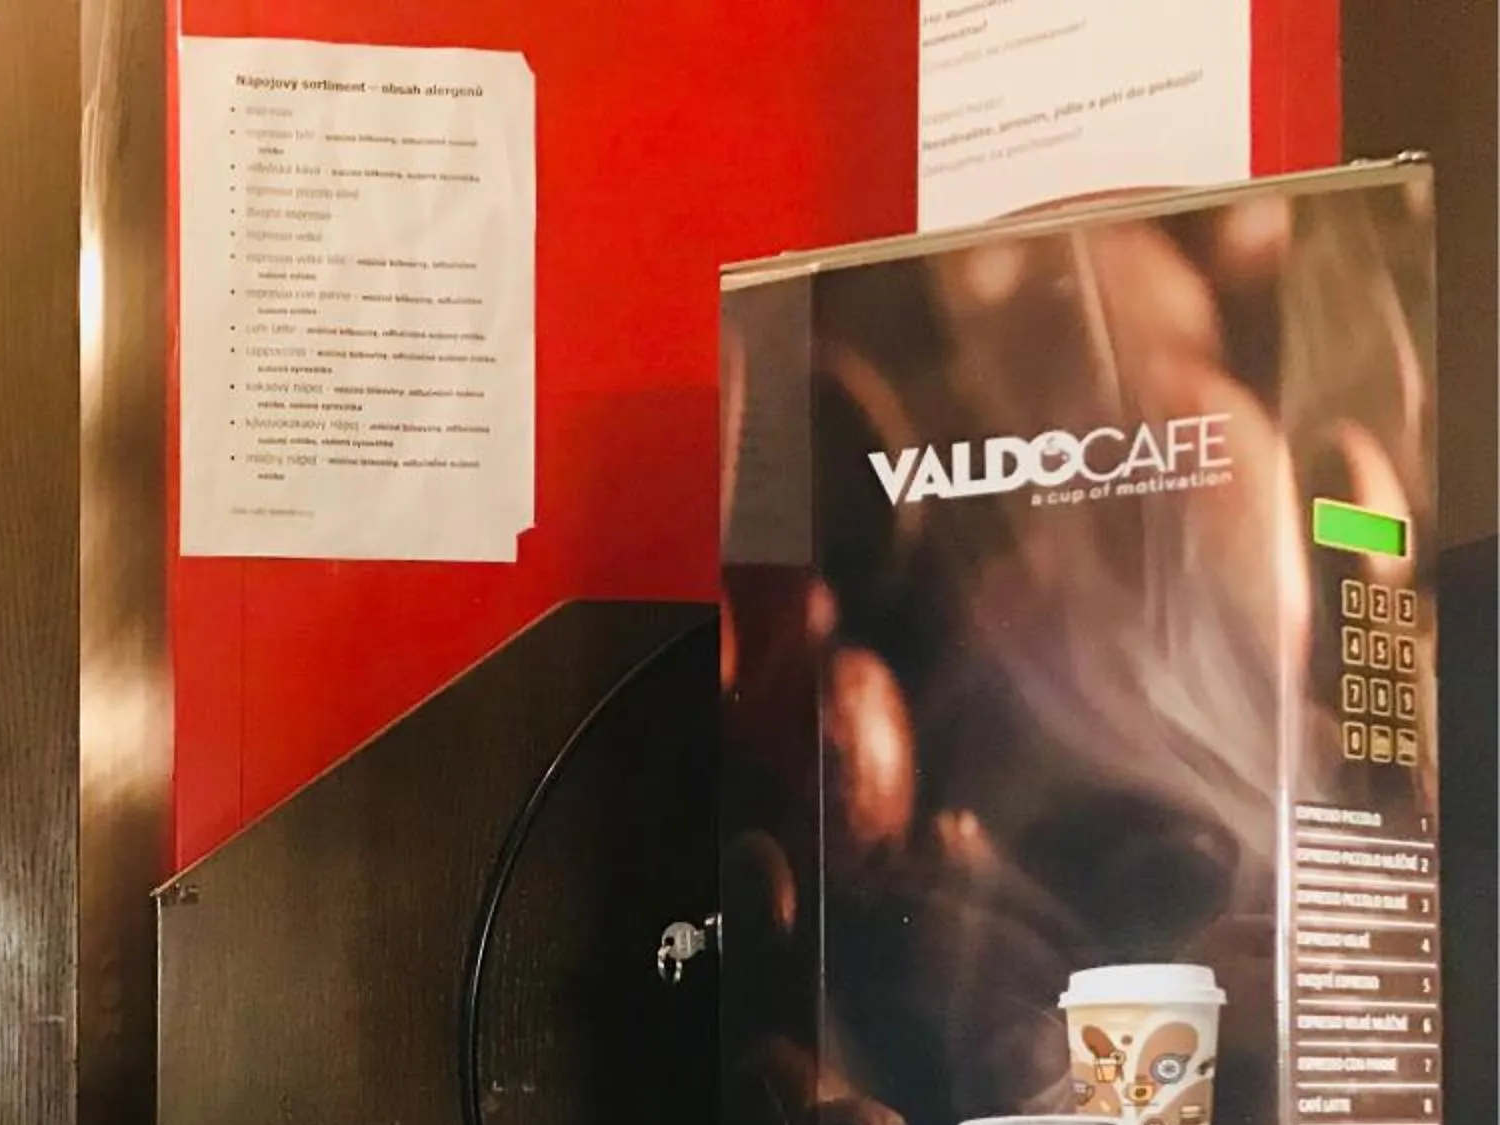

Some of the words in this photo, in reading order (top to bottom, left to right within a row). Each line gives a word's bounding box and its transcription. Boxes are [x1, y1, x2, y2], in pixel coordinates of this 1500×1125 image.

[1030, 493, 1042, 507] a
[1047, 488, 1084, 505] cup
[1089, 483, 1110, 499] of
[1116, 471, 1234, 496] motivation
